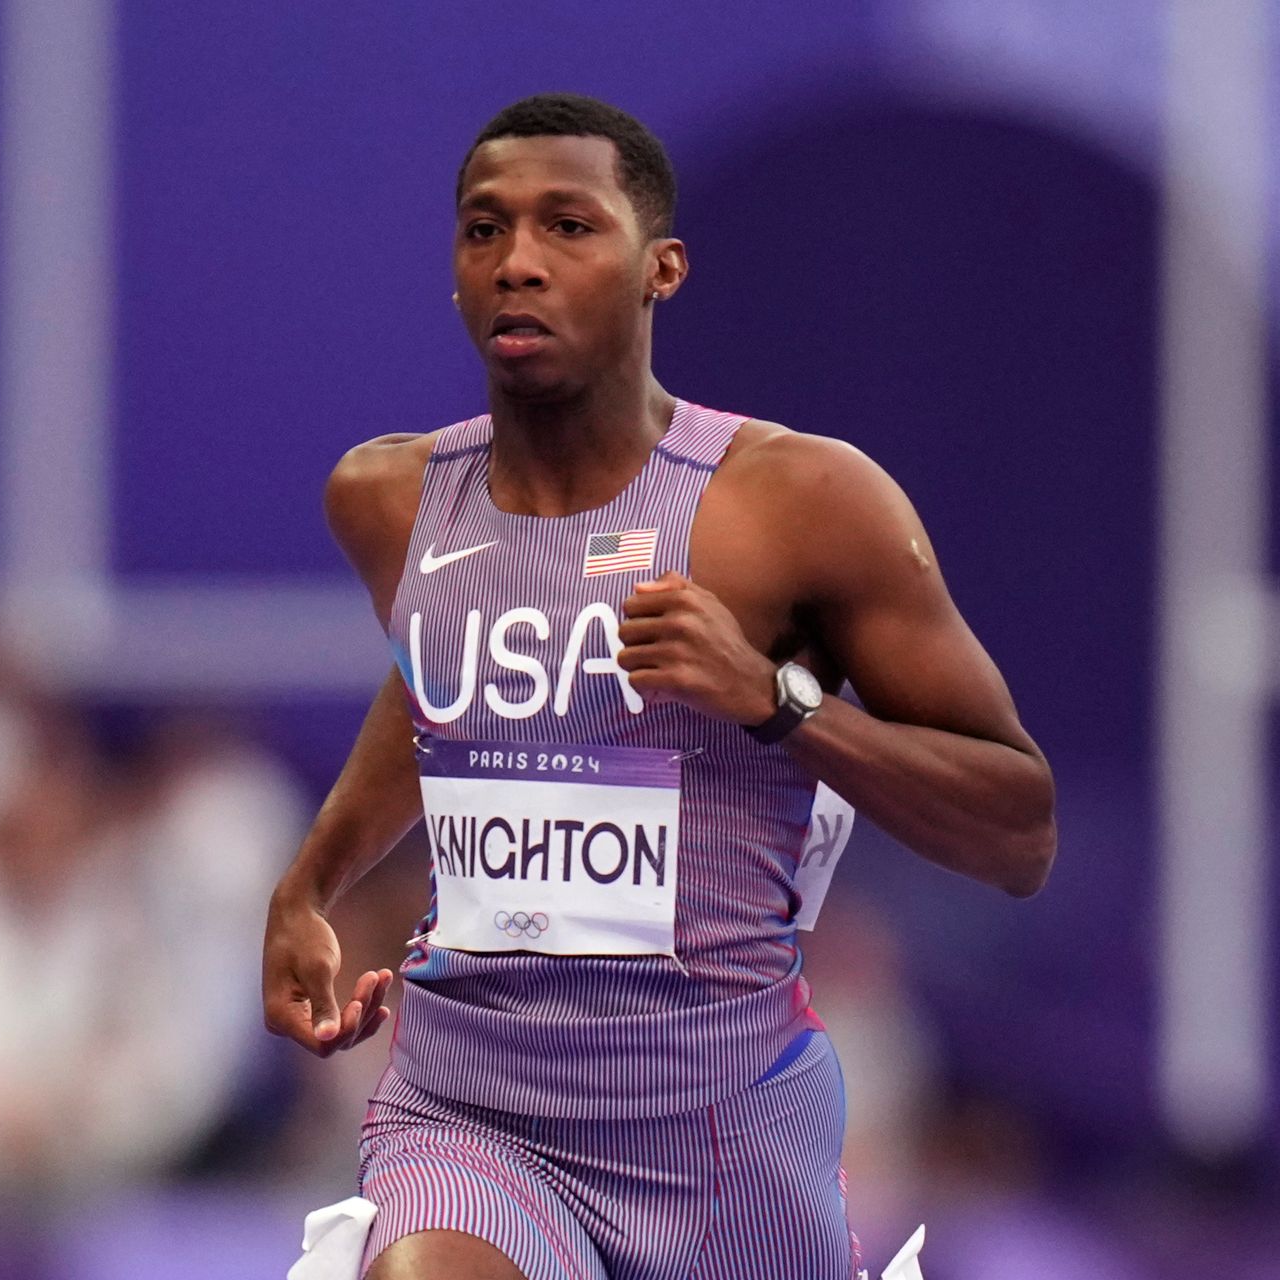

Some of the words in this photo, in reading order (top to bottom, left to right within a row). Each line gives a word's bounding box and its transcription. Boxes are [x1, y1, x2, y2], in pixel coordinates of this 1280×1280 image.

[410, 602, 644, 723] USA
[536, 753, 600, 774] 2024
[430, 814, 667, 887] KNIGHTON
